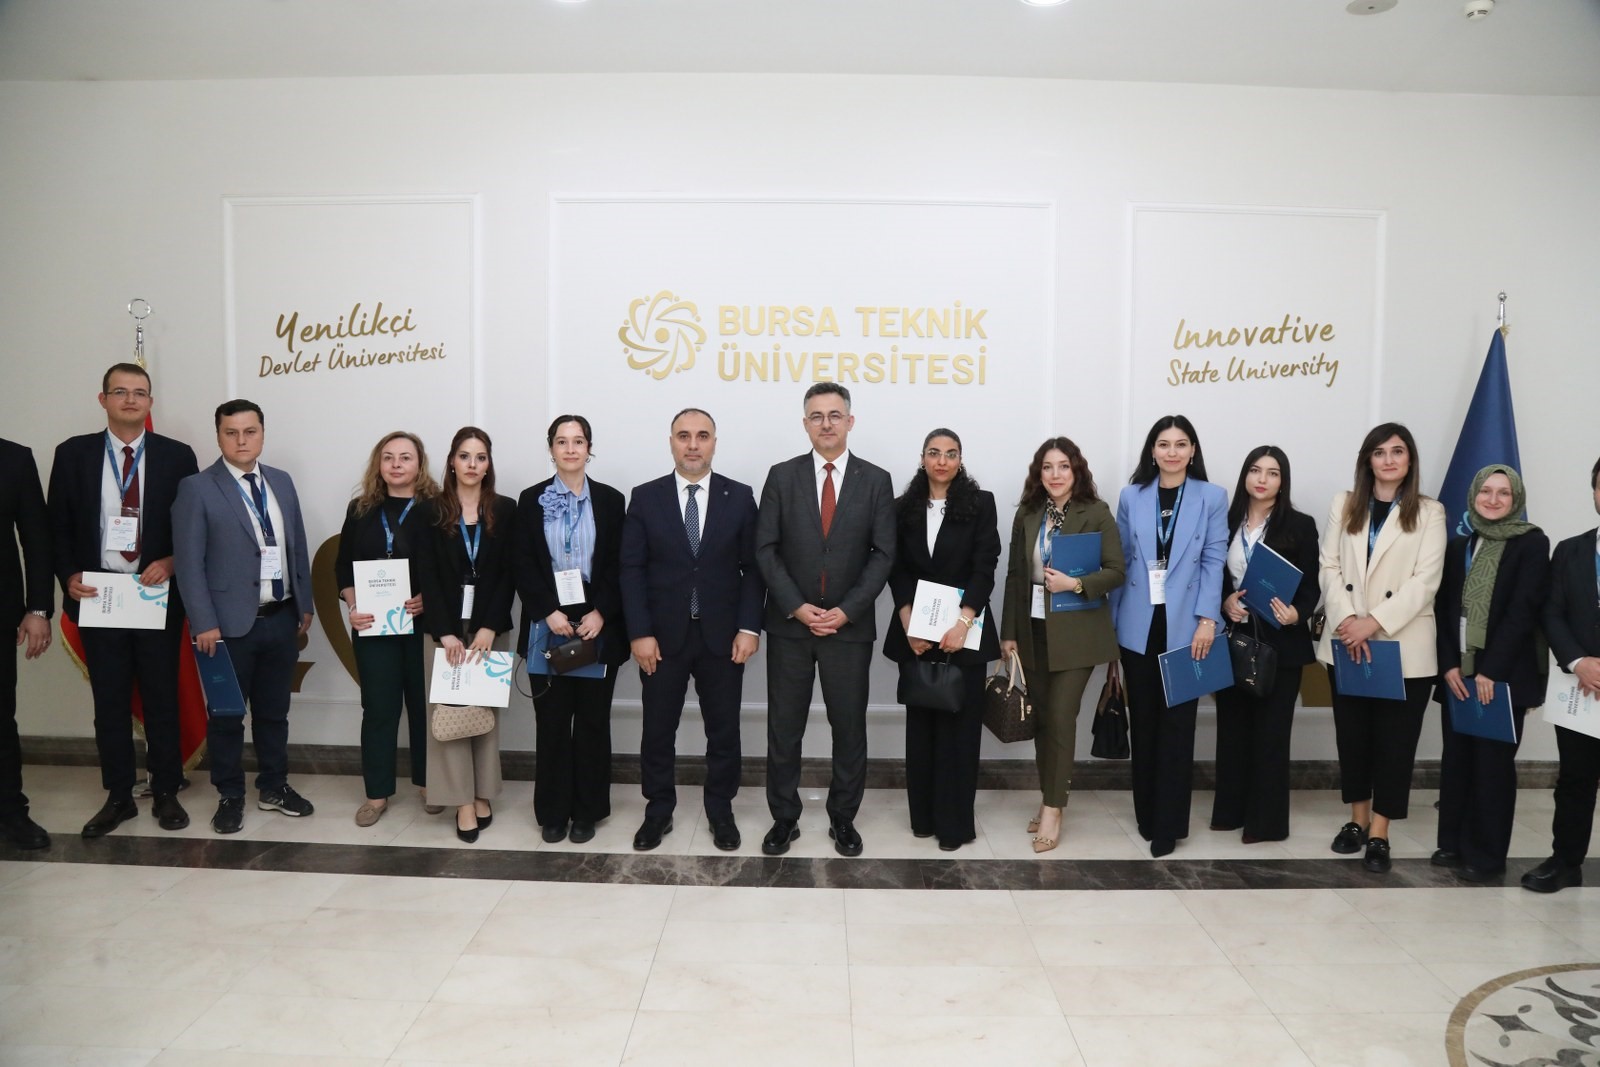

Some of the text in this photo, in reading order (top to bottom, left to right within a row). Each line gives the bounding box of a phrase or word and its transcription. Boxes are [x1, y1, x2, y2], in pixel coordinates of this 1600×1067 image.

[275, 302, 417, 353] Yenilikçi
[718, 300, 988, 339] BURSA TEKNİK
[1173, 313, 1336, 350] Innovative
[259, 342, 447, 377] Devlet Üniversitesi
[717, 342, 987, 385] ÜNİVERSİTESİ
[1167, 352, 1339, 388] State University
